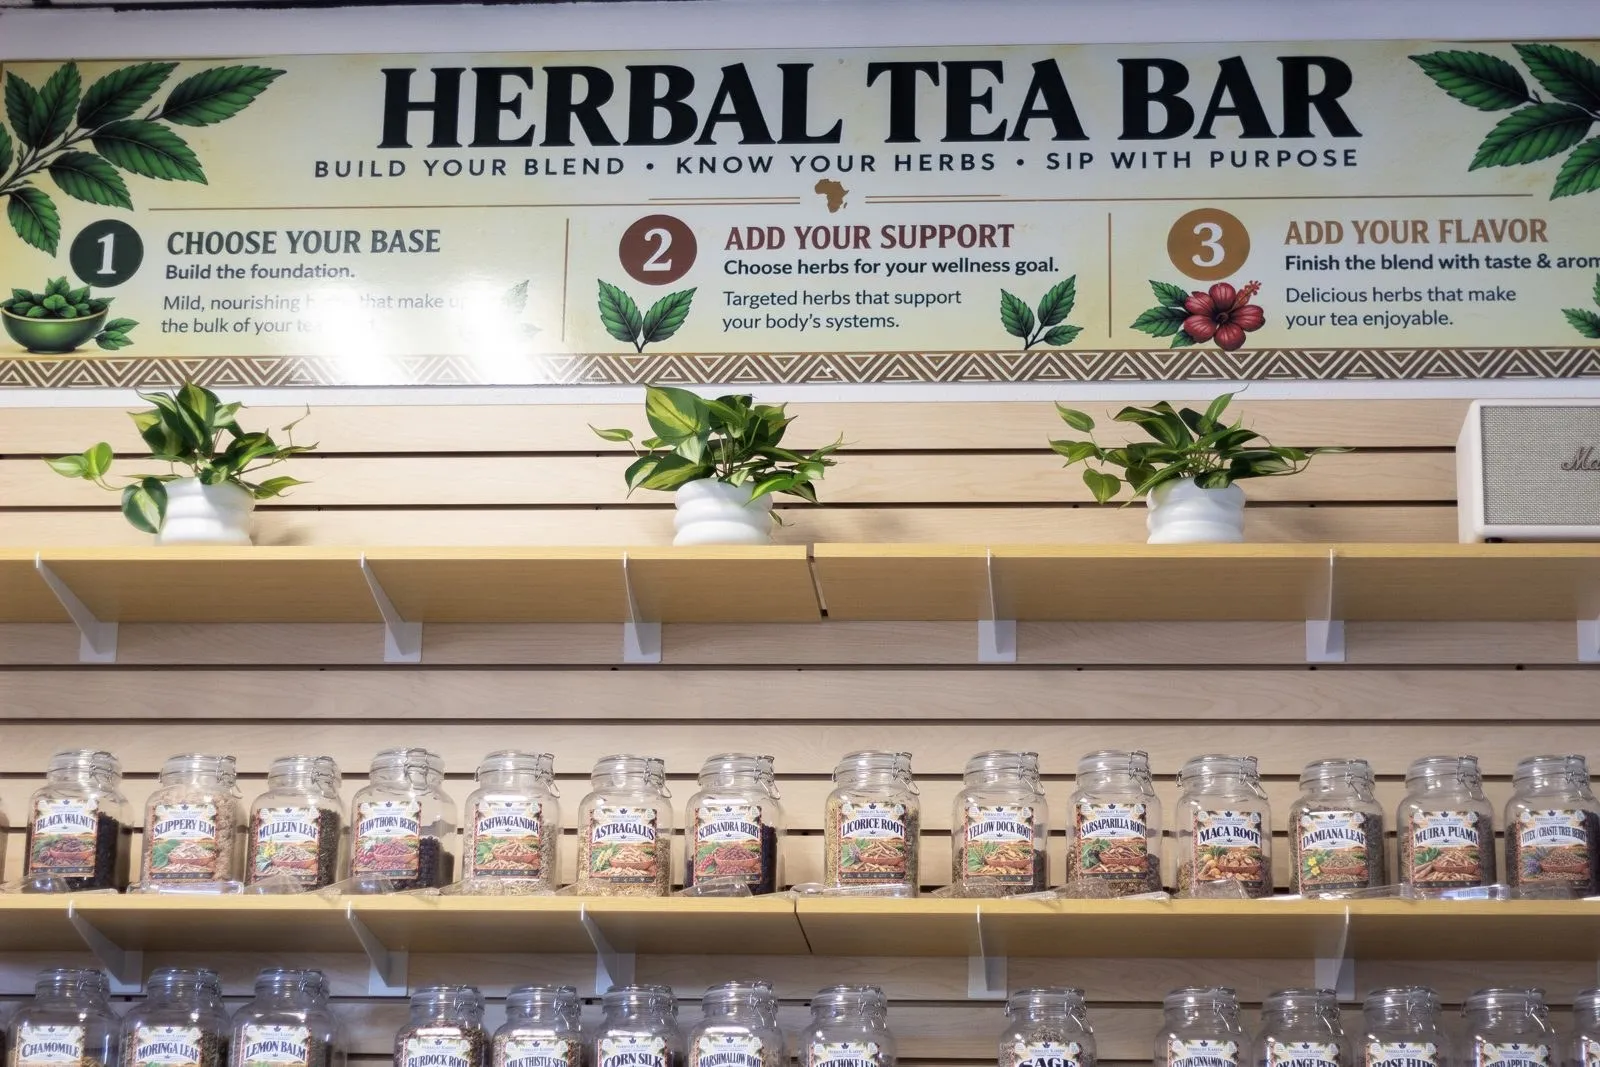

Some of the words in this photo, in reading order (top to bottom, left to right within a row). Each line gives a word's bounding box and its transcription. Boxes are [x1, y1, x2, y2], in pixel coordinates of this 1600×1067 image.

[377, 63, 842, 148] HERBAL
[867, 58, 1090, 143] TEA
[1117, 56, 1362, 140] BAR
[315, 160, 405, 177] BUILD
[423, 159, 506, 176] YOUR
[525, 158, 624, 175] BLEND
[677, 156, 773, 174] KNOW
[791, 155, 875, 172] YOUR
[895, 153, 994, 171] HERBS
[1047, 153, 1093, 170] SIP
[1111, 151, 1190, 169] WITH
[1211, 149, 1357, 168] PURPOSE
[724, 227, 785, 250] ADD
[794, 226, 871, 249] YOUR
[881, 224, 1014, 249] SUPPORT
[1285, 221, 1343, 245] ADD
[1351, 220, 1429, 244] YOUR
[1439, 219, 1548, 243] FLAVOR
[167, 231, 277, 255] CHOOSE
[286, 230, 360, 254] YOUR
[371, 229, 440, 253] BASE
[643, 229, 672, 271] 2
[1192, 223, 1224, 266] 3
[97, 234, 116, 274] 1
[1286, 255, 1339, 270] Finish
[1345, 255, 1375, 270] the
[1381, 254, 1433, 270] blend
[1439, 254, 1479, 269] with
[1485, 255, 1531, 269] taste
[1537, 253, 1551, 268] &
[166, 264, 211, 279] Build
[216, 264, 245, 279] the
[250, 264, 354, 278] foundation.
[724, 260, 792, 274] Choose
[798, 259, 849, 274] herbs
[854, 259, 881, 273] for
[886, 263, 927, 279] your
[932, 258, 1010, 272] wellness
[1015, 257, 1058, 275] goal.
[164, 296, 204, 312] Mild,
[211, 295, 301, 314] nourishing
[399, 293, 444, 309] make
[723, 291, 797, 309] Targeted
[803, 290, 852, 305] herbs
[857, 290, 889, 304] that
[895, 291, 961, 307] support
[1287, 288, 1367, 302] Delicious
[1373, 287, 1422, 302] herbs
[1427, 286, 1463, 301] that
[1469, 286, 1516, 301] make
[161, 318, 188, 333] the
[194, 318, 228, 332] bulk
[233, 318, 251, 332] of
[254, 322, 292, 339] your
[723, 318, 762, 335] your
[766, 313, 820, 331] body’s
[826, 315, 899, 331] systems.
[1286, 315, 1326, 332] your
[1330, 313, 1357, 326] tea
[1363, 310, 1453, 329] enjoyable.
[37, 813, 63, 830] BLACK
[64, 813, 96, 831] WALNUT
[155, 818, 198, 838] SLIPPERY
[199, 820, 215, 837] ELM
[259, 821, 297, 839] MULLEIN
[299, 822, 318, 839] LEAF
[359, 815, 399, 835] HAWTHORN
[479, 815, 539, 833] ASHWAGANDHA
[594, 822, 655, 841] ASTRAGALUS
[698, 820, 739, 840] SCHISANDRA
[740, 822, 759, 838] BERRY
[842, 818, 880, 836] LICORICE
[881, 819, 905, 836] ROOT
[969, 821, 996, 839] YELLOW
[996, 820, 1015, 833] DOCK
[1016, 822, 1031, 841] ROOT
[1081, 818, 1129, 837] SARSAPARILLA
[1130, 819, 1146, 836] ROOT
[1539, 826, 1557, 837] CHASTE
[1558, 826, 1571, 837] TREE
[1199, 825, 1232, 844] MACA
[1233, 826, 1260, 844] ROOT
[1302, 827, 1344, 849] DAMIANA
[1345, 829, 1365, 845] LEAF
[1414, 826, 1446, 846] MUIRA
[1447, 825, 1479, 845] PUAMA
[22, 1042, 80, 1058] CHAMOMILE
[137, 1042, 178, 1060] MORINGA
[180, 1043, 199, 1061] LEAF
[246, 1041, 280, 1057] LEMON
[281, 1041, 306, 1058] BALM
[408, 1054, 447, 1067] BURDOCK
[524, 1056, 552, 1067] THISTLE
[603, 1053, 638, 1067] CORN
[639, 1053, 663, 1067] SILK
[700, 1052, 746, 1067] MARSHMALLOW
[816, 1058, 860, 1067] TICHOKE
